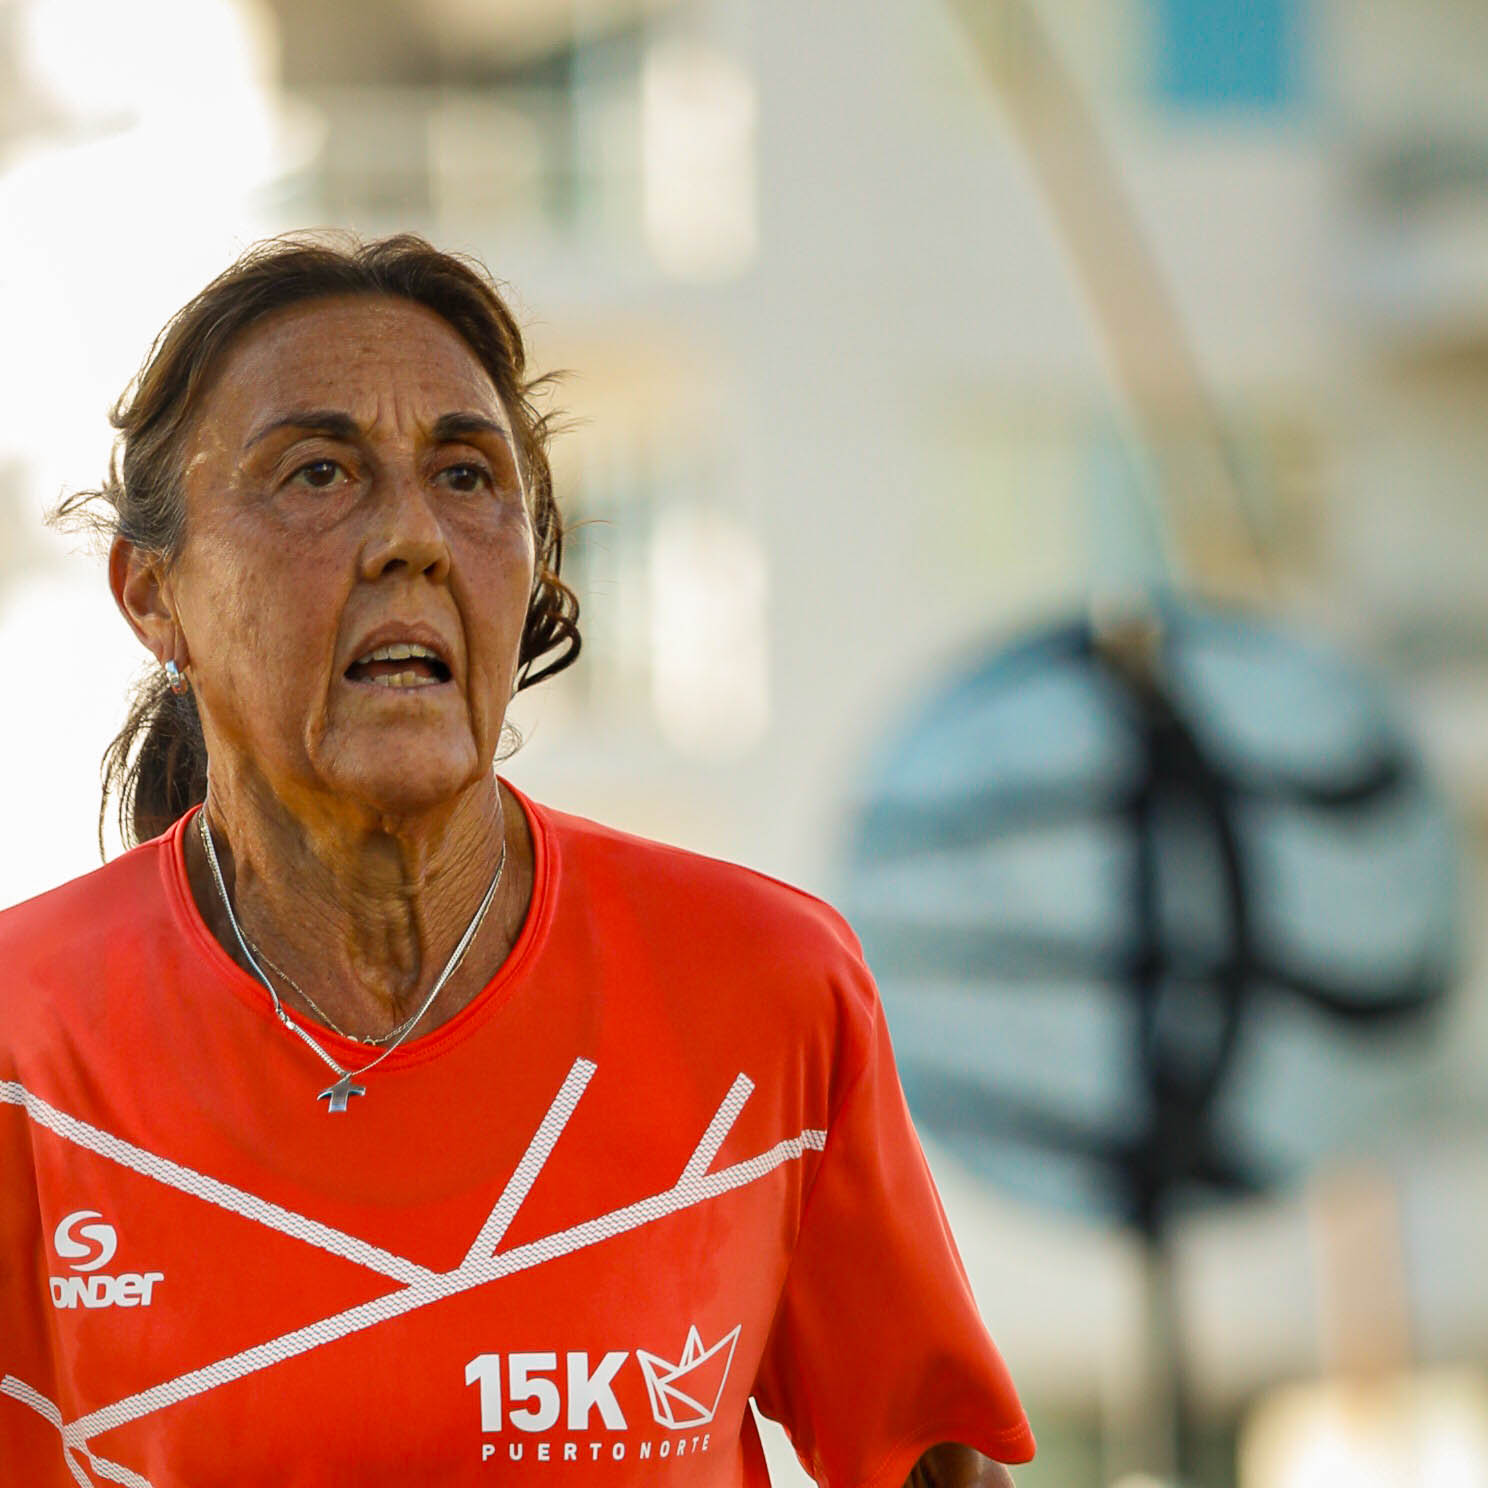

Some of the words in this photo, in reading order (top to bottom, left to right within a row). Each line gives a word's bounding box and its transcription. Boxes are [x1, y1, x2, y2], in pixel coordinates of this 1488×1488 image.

[464, 1350, 630, 1433] 15K
[481, 1442, 626, 1462] PUERTO
[639, 1434, 711, 1459] NORTE
